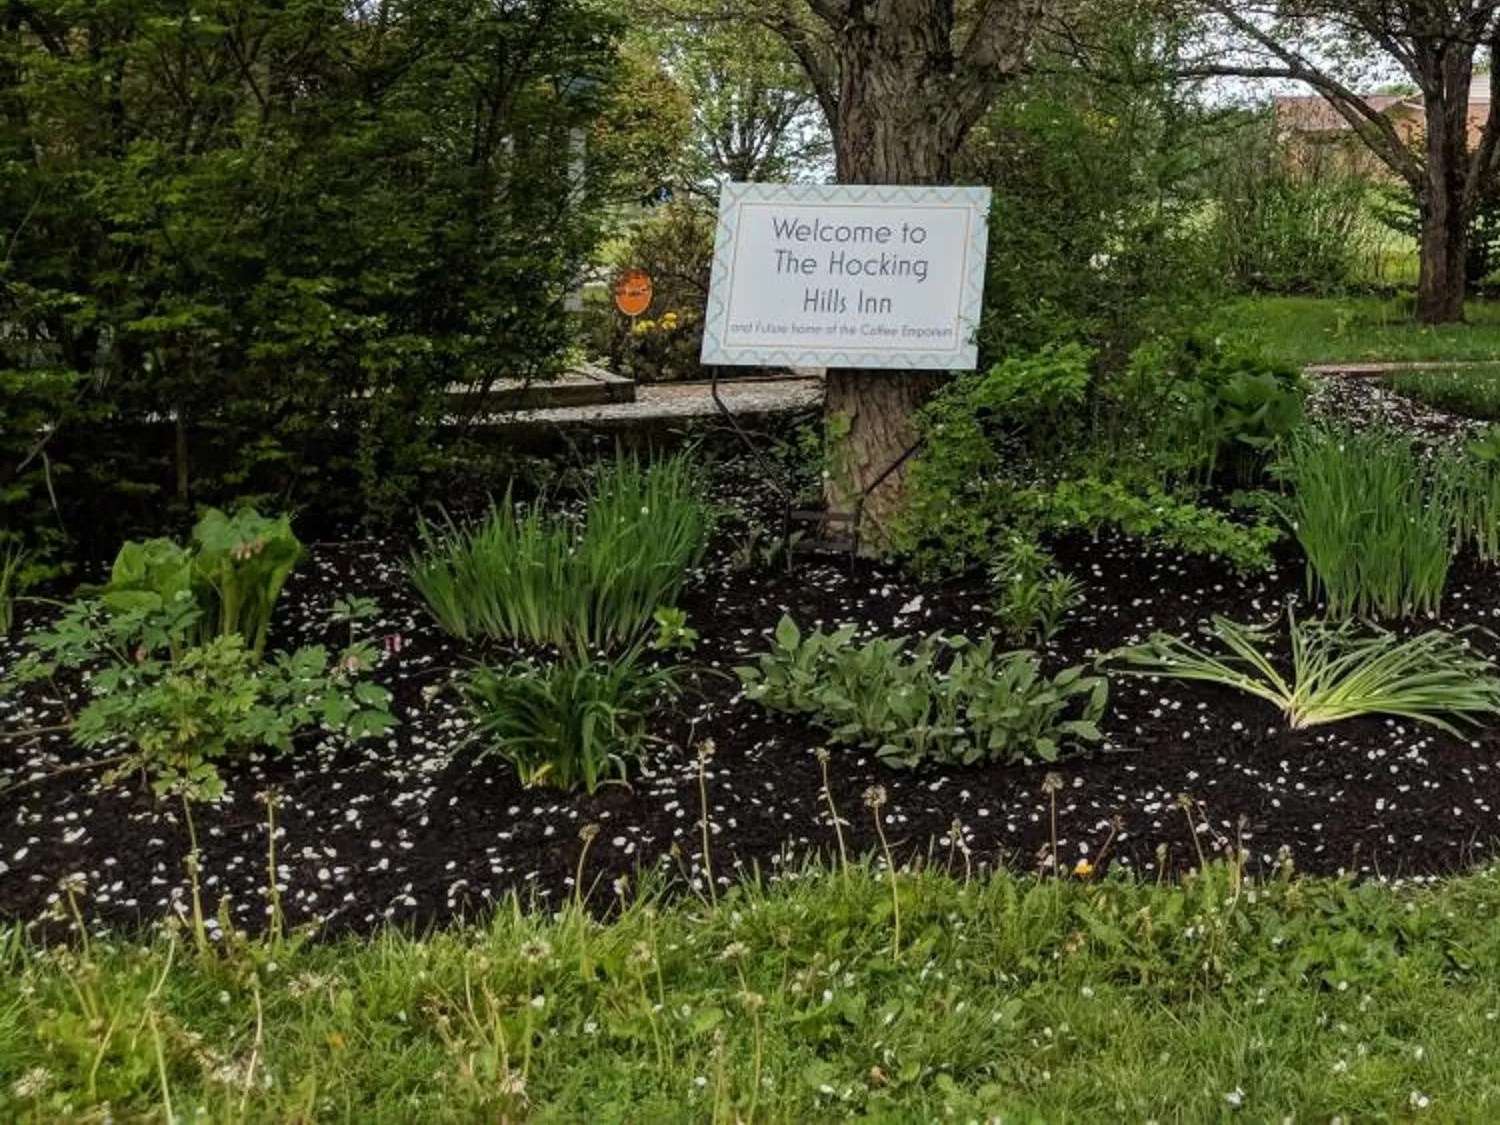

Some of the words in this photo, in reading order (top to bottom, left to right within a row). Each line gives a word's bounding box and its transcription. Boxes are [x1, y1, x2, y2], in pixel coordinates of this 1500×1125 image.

[772, 216, 892, 244] Welcome
[902, 223, 927, 245] to
[773, 249, 817, 274] The
[828, 251, 929, 283] Hocking
[802, 288, 847, 314] Hills
[856, 291, 892, 314] Inn
[731, 321, 752, 333] and
[791, 321, 823, 334] home
[839, 321, 857, 336] the
[860, 322, 897, 337] Coffee
